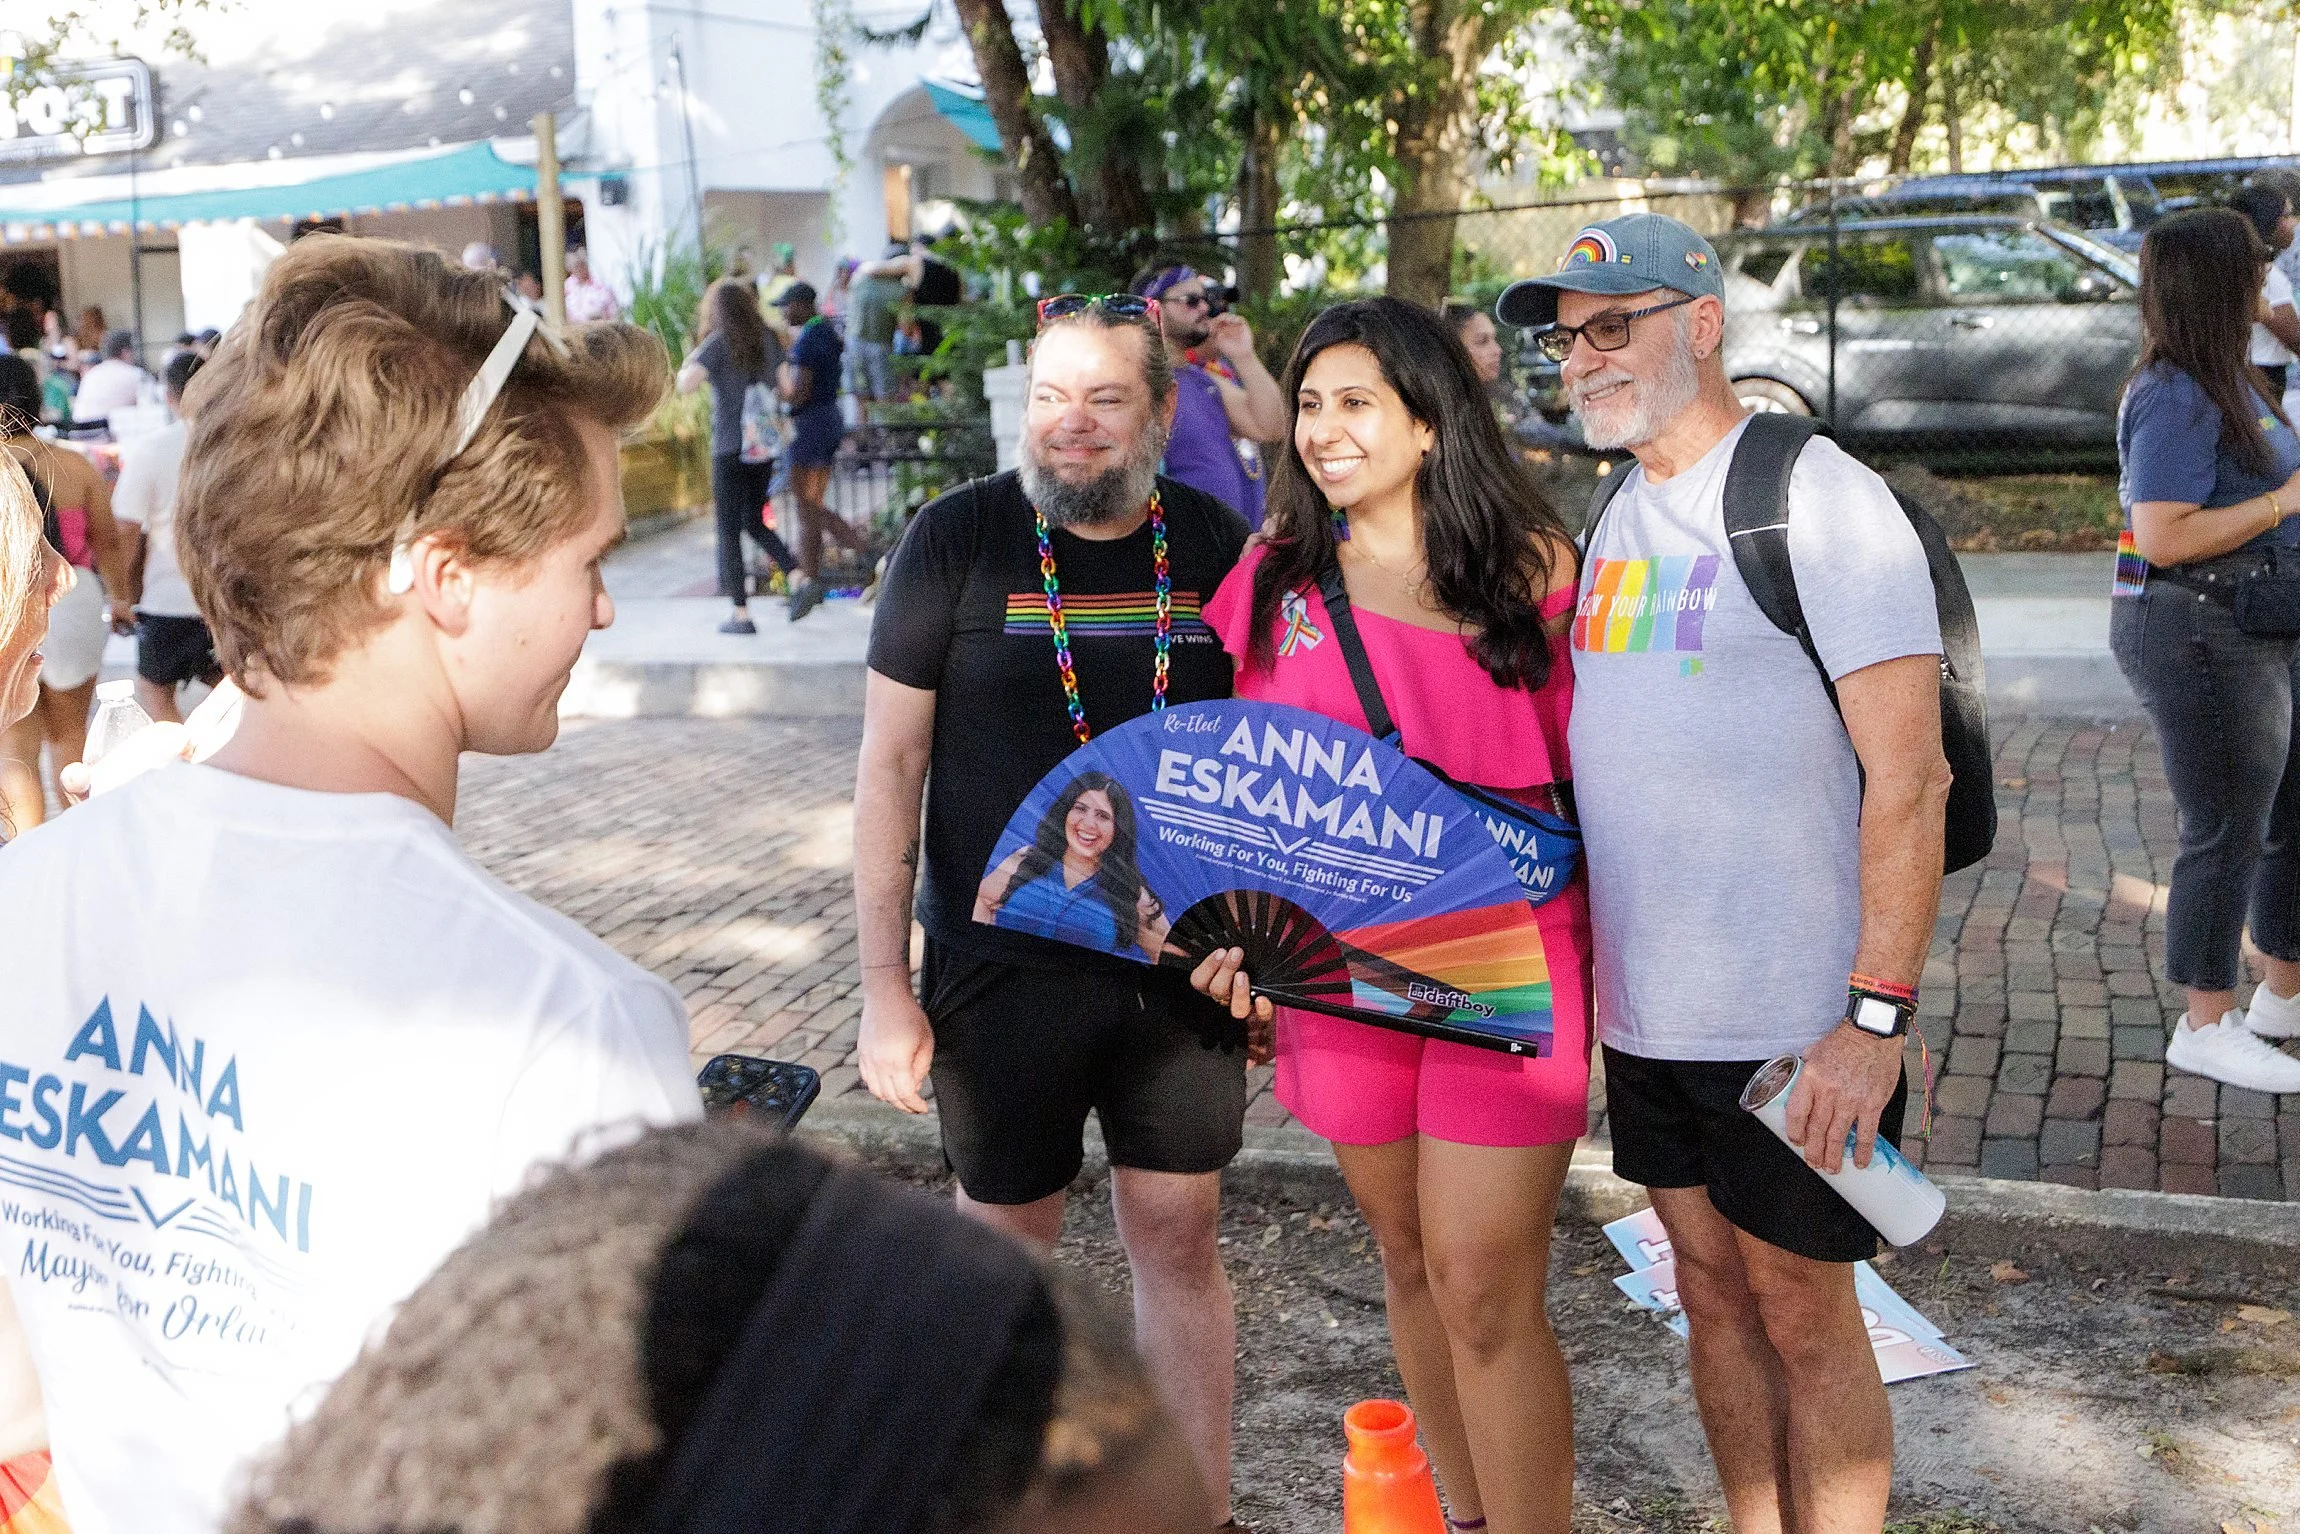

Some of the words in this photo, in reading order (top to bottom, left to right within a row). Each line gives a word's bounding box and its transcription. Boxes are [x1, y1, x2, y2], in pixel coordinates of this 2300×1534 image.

[1185, 634, 1213, 644] WINS
[1608, 595, 1647, 618] YOUR
[1649, 587, 1718, 617] RAINBOW
[1163, 713, 1222, 734] Re-Elect
[1219, 716, 1382, 795] ANNA
[1155, 749, 1443, 858] ESKAMANI
[1158, 826, 1223, 858] Working
[1227, 842, 1254, 864] For
[1257, 851, 1289, 876] You,
[1293, 862, 1357, 894] Fighting
[1360, 878, 1389, 898] For
[1391, 885, 1413, 902] Us
[1425, 987, 1495, 1018] daftboy
[64, 992, 244, 1133] ANNA
[0, 1060, 313, 1254] ESKAMANI
[1, 1200, 82, 1242] Working
[106, 1241, 155, 1277] You,
